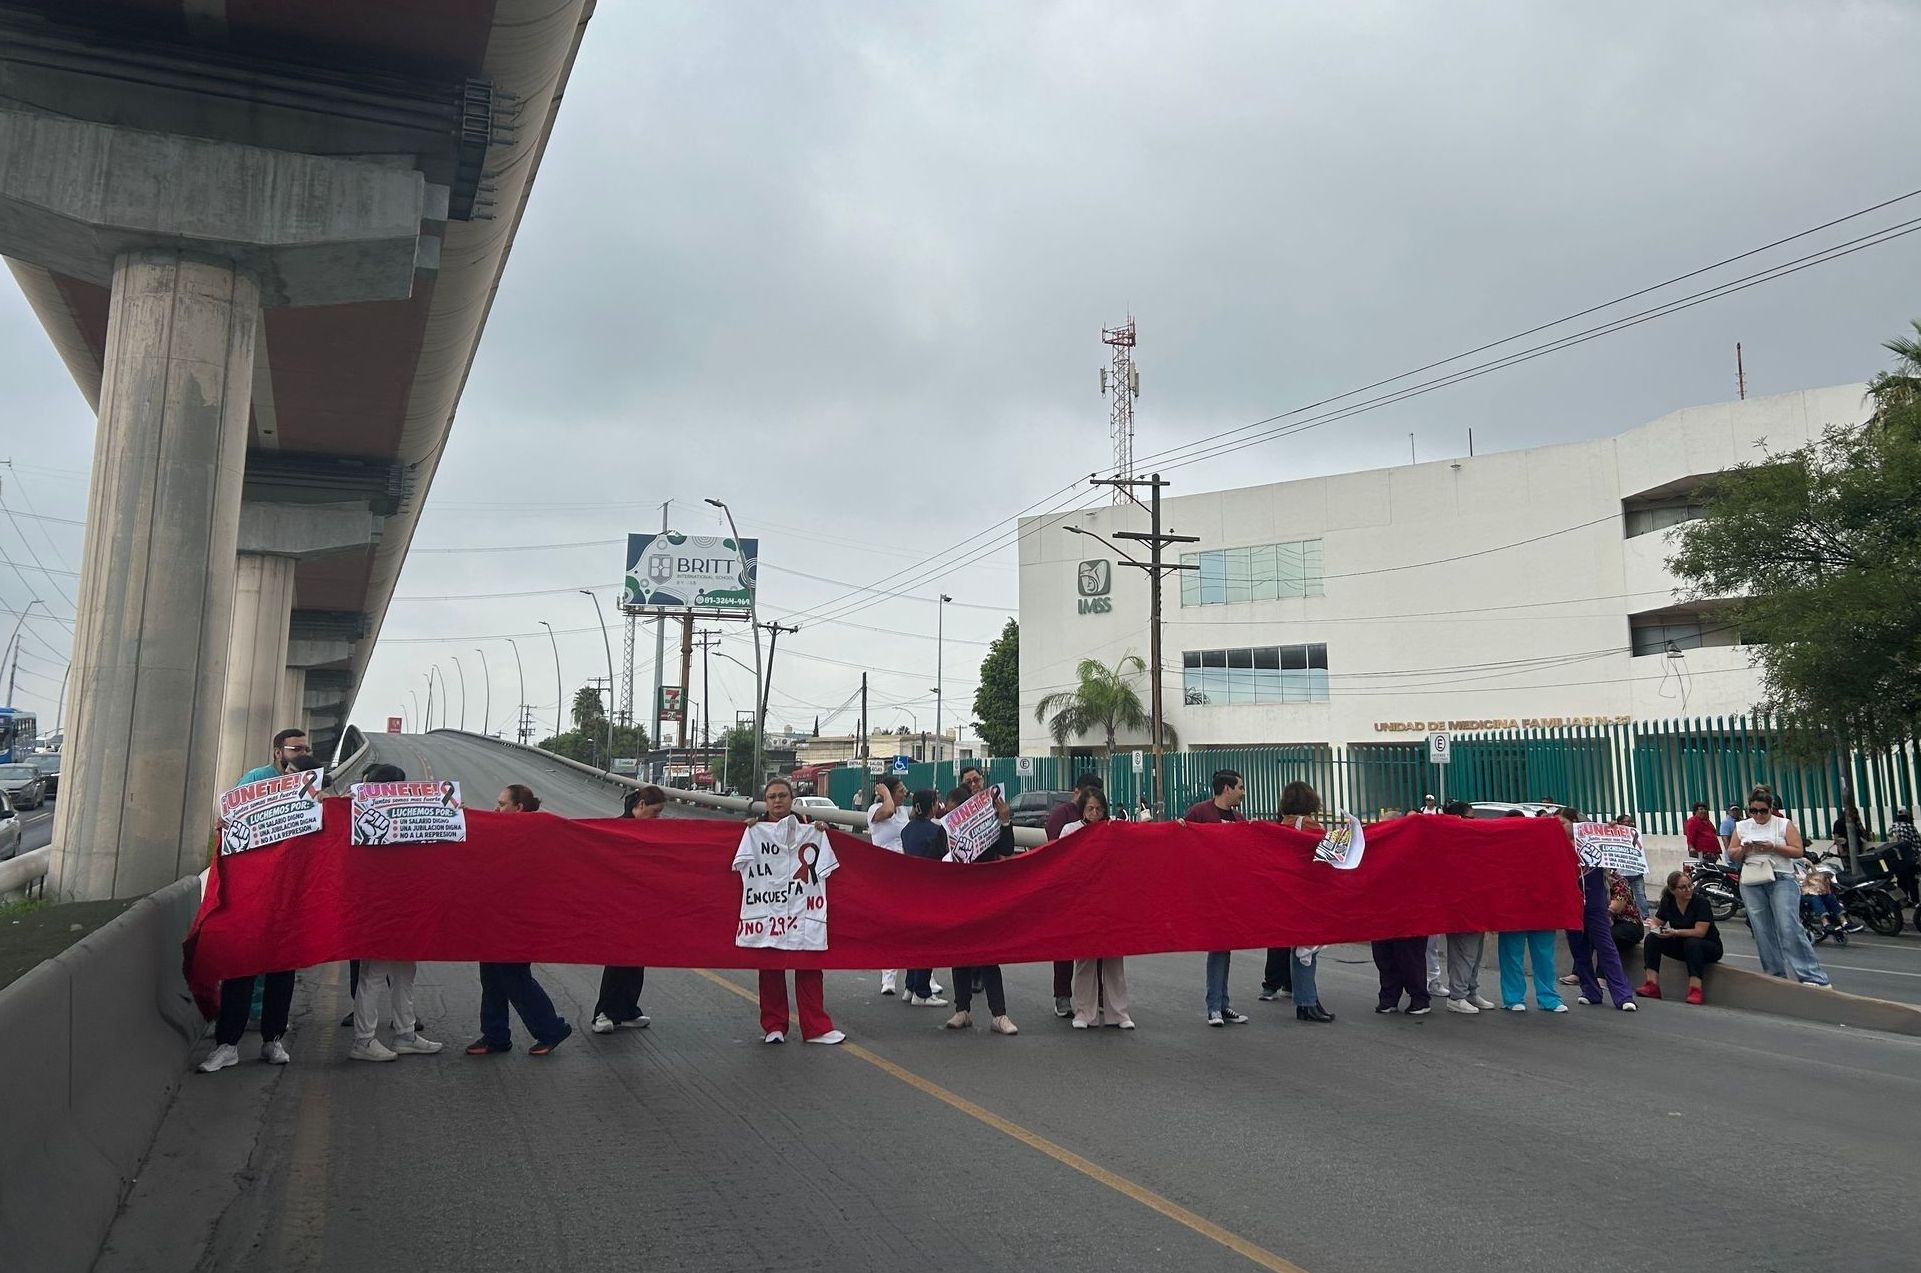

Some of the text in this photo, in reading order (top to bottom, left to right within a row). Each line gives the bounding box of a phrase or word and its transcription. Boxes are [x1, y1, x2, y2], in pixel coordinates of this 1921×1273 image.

[677, 558, 735, 574] BRITT
[704, 597, 750, 605] 81-3264-969
[1078, 597, 1112, 614] IMSS
[1374, 722, 1425, 732] UNIDAD
[1428, 721, 1446, 731] DE
[1448, 719, 1518, 730] MEDICINA
[250, 801, 310, 823] LUCHEMOS POR:
[392, 808, 453, 817] LUCHEMOS POR:
[266, 817, 286, 829] SALARIO
[287, 813, 304, 821] DIGNO
[300, 817, 317, 826] DIGNA
[261, 836, 269, 844] NO
[274, 832, 281, 840] LA
[281, 825, 312, 838] REPRESION
[761, 842, 780, 855] NO
[1602, 845, 1629, 854] LUCHEMOS
[748, 863, 773, 879] A LA
[746, 881, 804, 905] ENCUESTA
[806, 896, 824, 910] NO
[745, 922, 763, 935] NO
